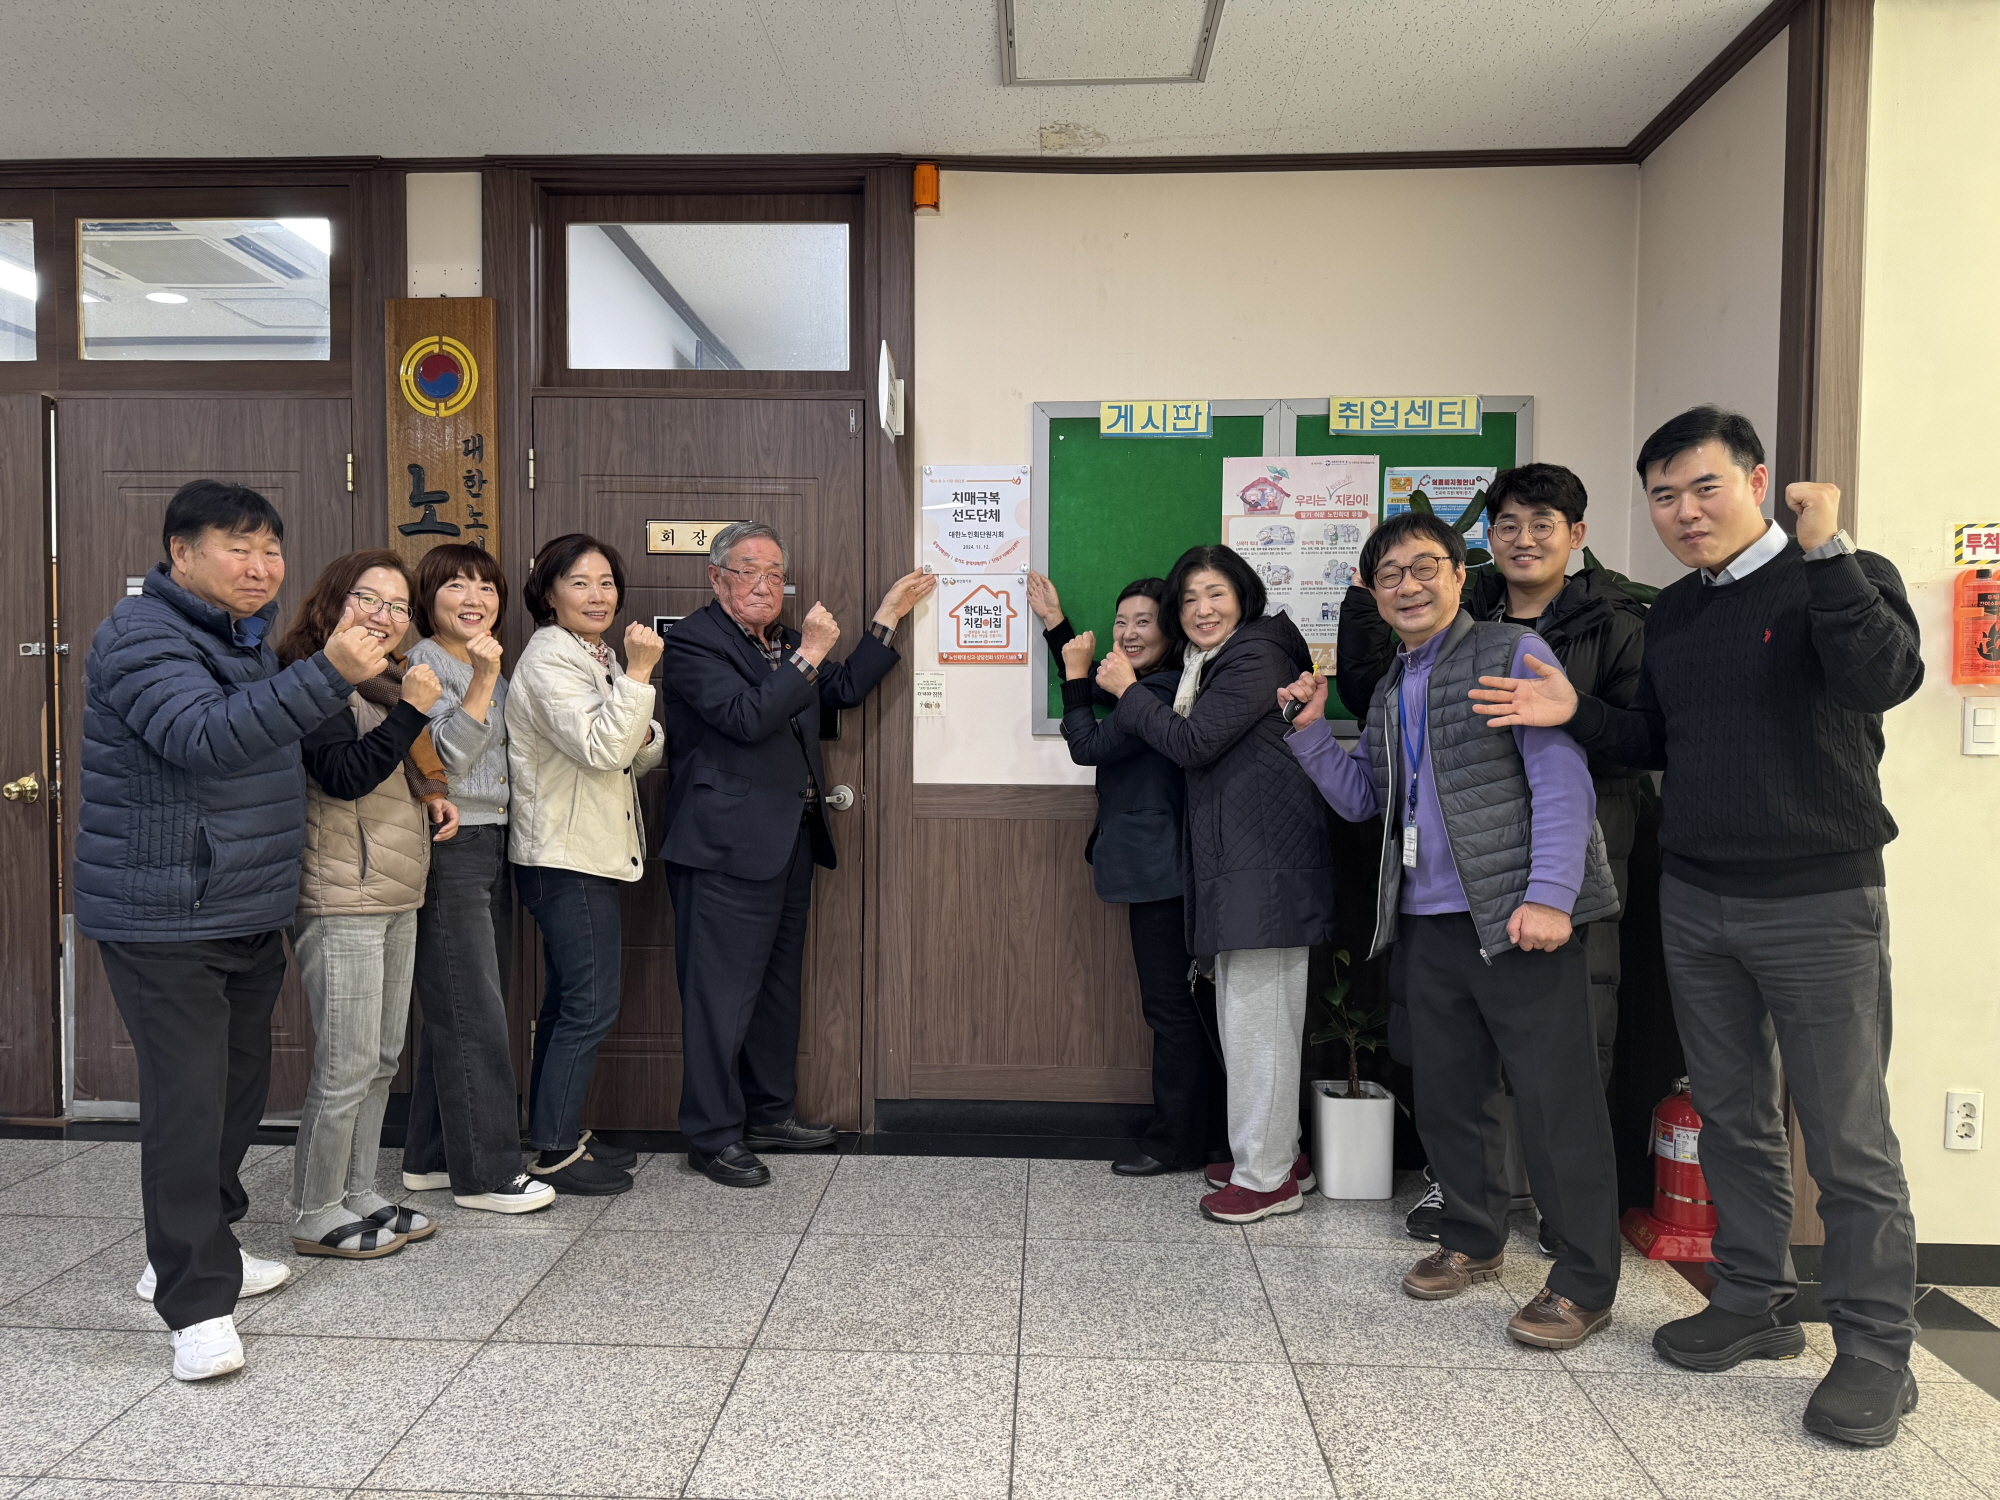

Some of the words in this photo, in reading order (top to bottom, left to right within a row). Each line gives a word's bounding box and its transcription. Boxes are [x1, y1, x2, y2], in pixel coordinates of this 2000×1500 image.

[1106, 403, 1202, 432] 게시판
[1338, 399, 1466, 429] 취업센터
[951, 491, 1001, 505] 치매극복
[1294, 494, 1327, 507] 우리는
[1335, 494, 1369, 506] 지킴이!
[952, 508, 1000, 523] 선도단체
[948, 530, 1004, 539] 대한노인회단원지회
[1966, 533, 2000, 555] 투척
[963, 604, 1002, 616] 학대노인
[963, 617, 1002, 629] 지킴이집
